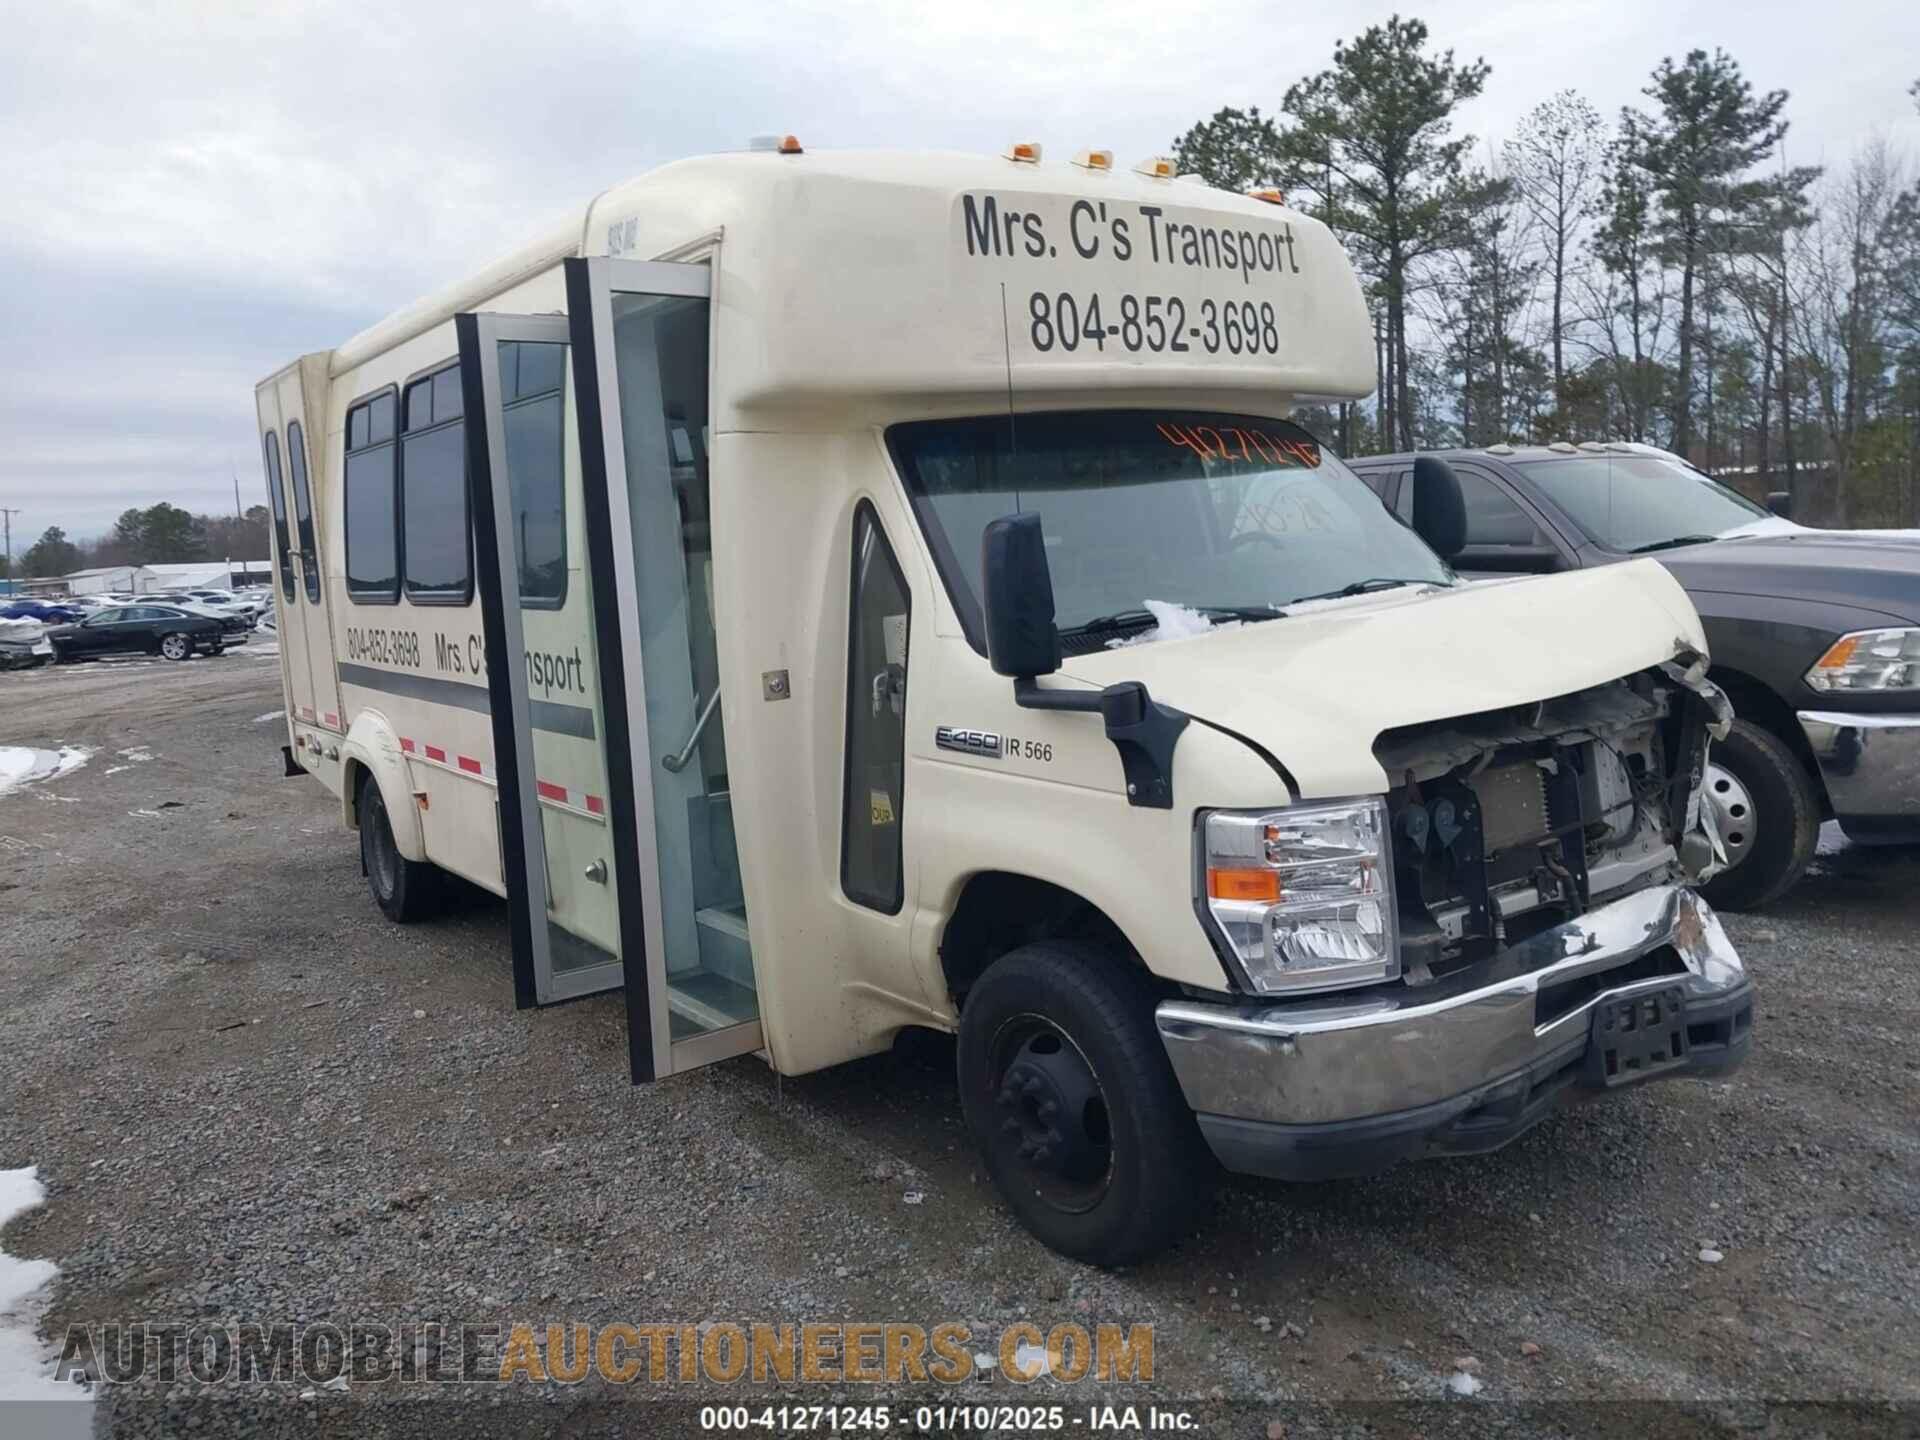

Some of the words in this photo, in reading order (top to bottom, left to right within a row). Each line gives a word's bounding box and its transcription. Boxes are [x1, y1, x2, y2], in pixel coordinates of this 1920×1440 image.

[963, 194, 1057, 258] Mrs.
[1070, 200, 1132, 261] C's
[1139, 206, 1299, 284] Transport
[1029, 292, 1279, 355] 804-852-3698
[347, 628, 421, 668] 804-852-3698
[434, 632, 465, 673] Mrs.
[1005, 737, 1020, 757] IR
[1025, 741, 1052, 762] 566
